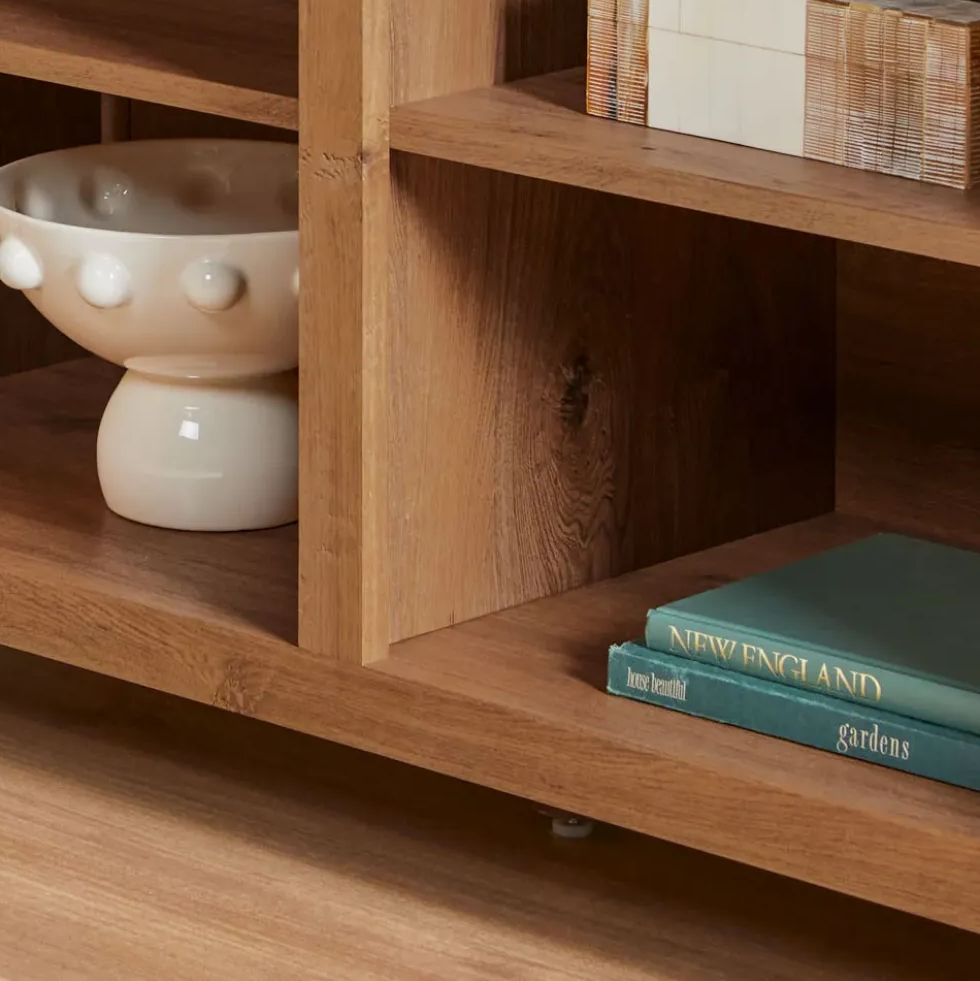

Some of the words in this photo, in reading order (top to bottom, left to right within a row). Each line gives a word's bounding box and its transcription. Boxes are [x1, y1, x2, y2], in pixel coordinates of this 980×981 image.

[668, 625, 737, 661] NEW
[742, 643, 882, 702] ENGLAND
[626, 666, 650, 692] house
[651, 672, 687, 701] beautiful
[836, 723, 910, 760] gardens
